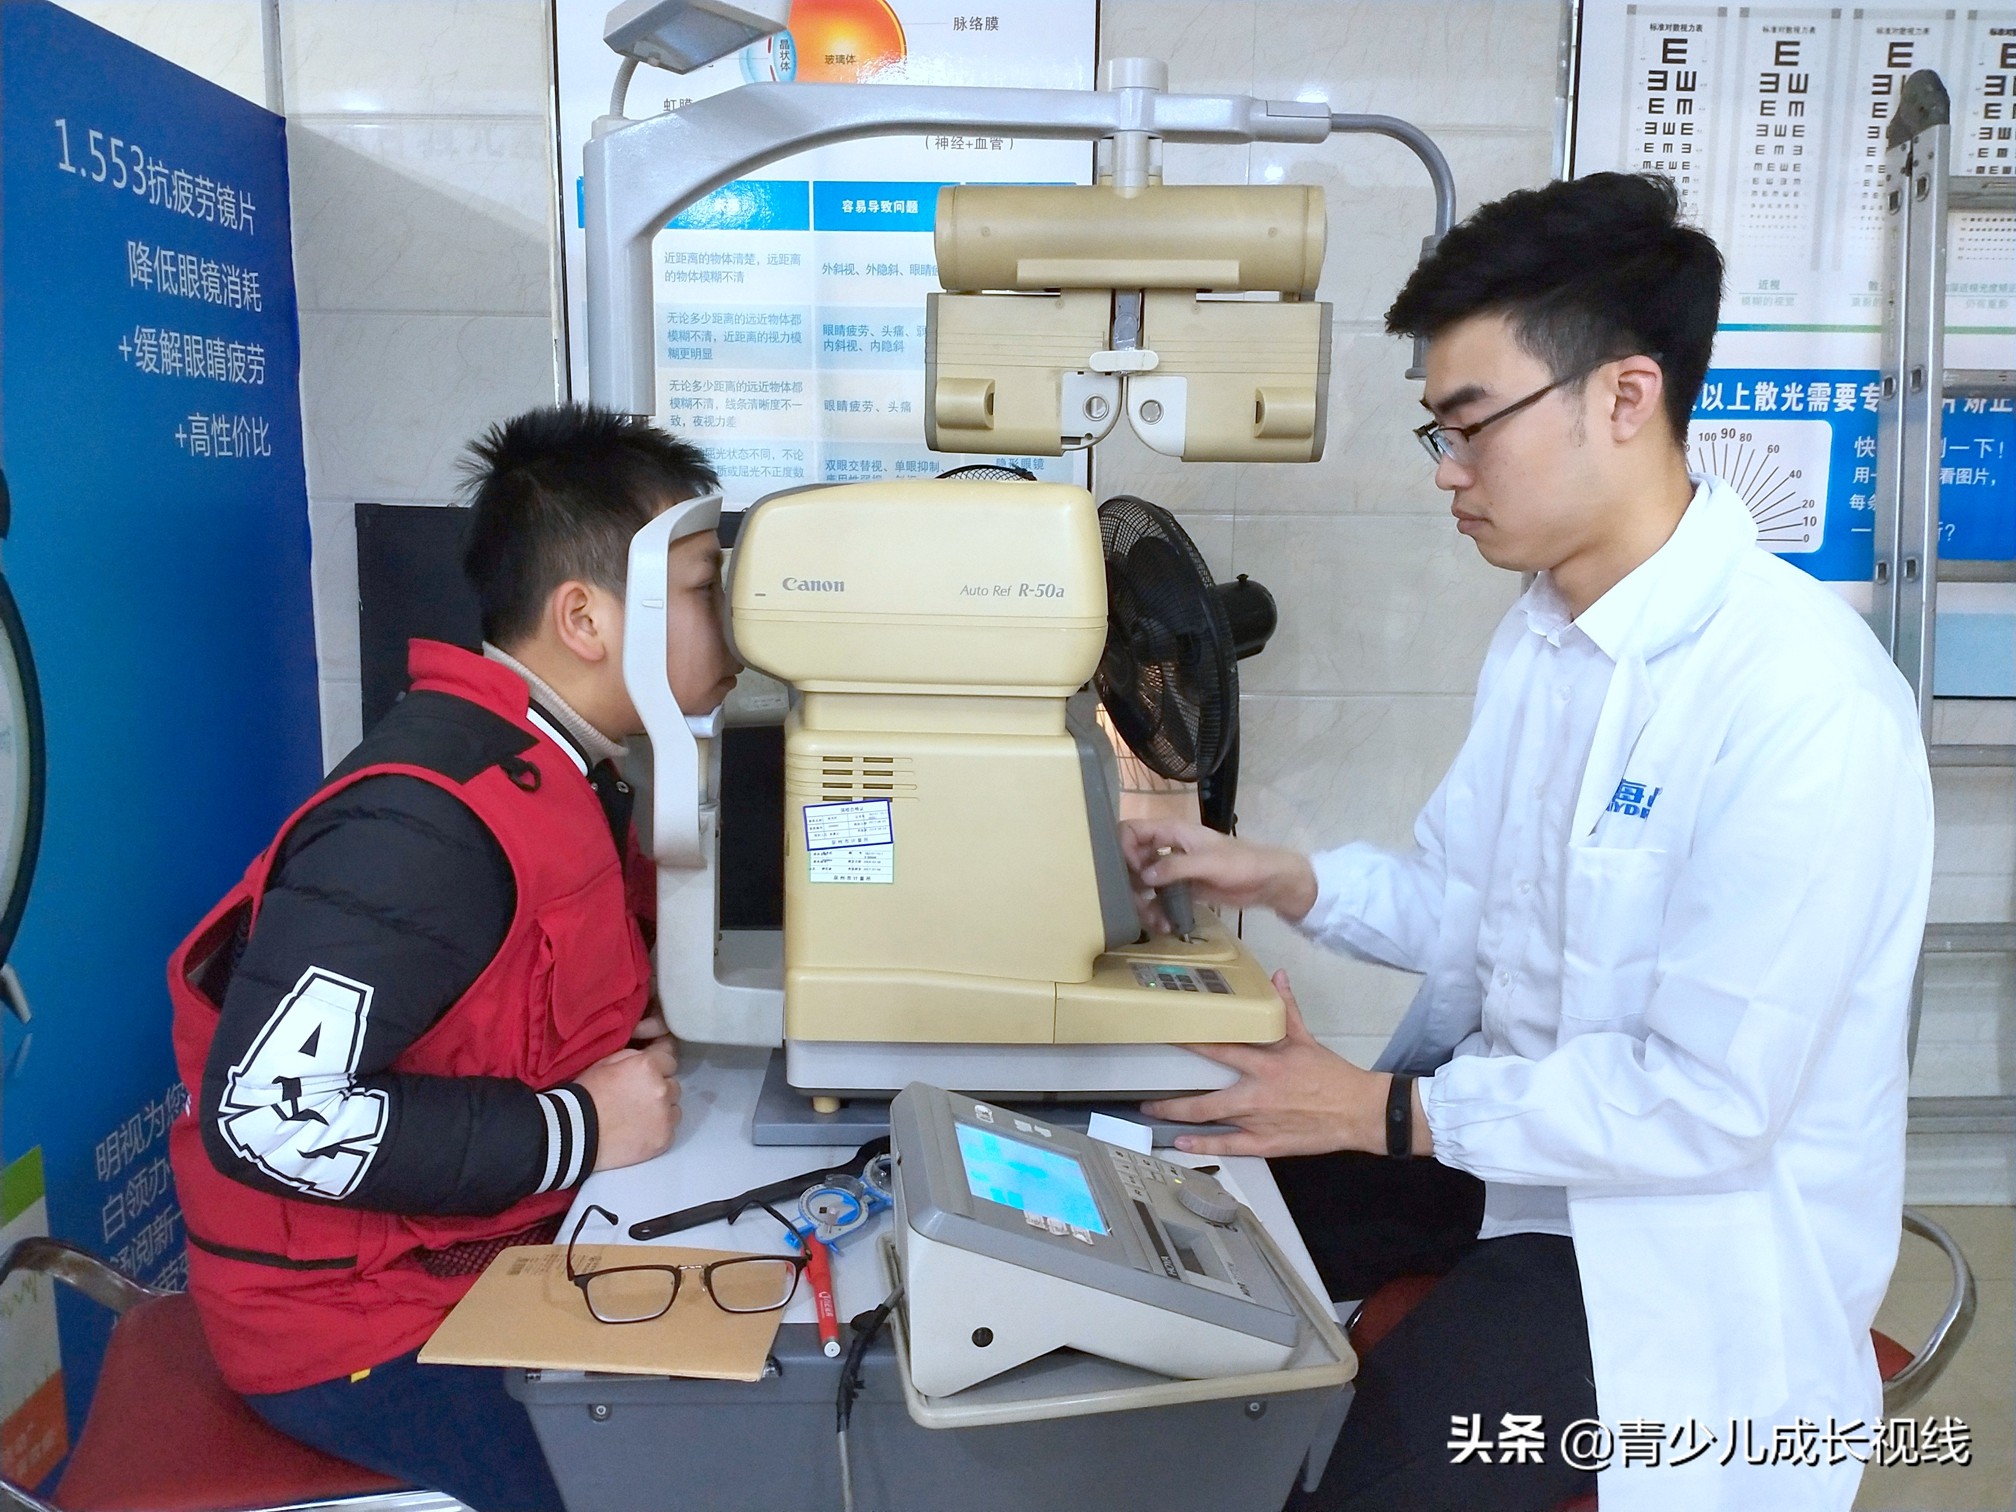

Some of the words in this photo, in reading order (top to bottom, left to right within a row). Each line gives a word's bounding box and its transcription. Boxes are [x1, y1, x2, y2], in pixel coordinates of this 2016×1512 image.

[953, 16, 1000, 32] 脉络膜
[778, 39, 791, 72] 晶状体
[824, 54, 857, 66] 玻璃体
[55, 117, 257, 236] 1.553抗疲劳镜片
[841, 199, 919, 214] 容易导致问题
[127, 240, 263, 313] 降低眼镜消耗
[664, 270, 744, 284] 的物体模糊不清
[667, 312, 801, 326] 无论多少距离的远近物体都
[667, 330, 802, 344] 模糊不清，近距离的视力模
[823, 338, 905, 353] 内斜视、内隐斜
[118, 325, 265, 385] +缓解眼睛疲劳
[667, 347, 714, 361] 糊更明显
[668, 380, 804, 395] 无论多少距离的远近物体都
[669, 398, 804, 412] 模糊不清，线条清晰度不一
[823, 400, 912, 414] 眼睛疲劳、头痛
[669, 415, 737, 428] 致，夜视力差
[175, 412, 272, 458] +高性价比
[1698, 432, 1717, 442] 100
[1720, 427, 1736, 439] 90
[1739, 433, 1753, 442] 80
[1767, 444, 1780, 454] 60
[1854, 435, 1876, 458] 快
[701, 447, 804, 462] 屈光状态不同，不论
[1788, 469, 1802, 480] 40
[1801, 499, 1815, 509] 20
[1802, 516, 1817, 527] 10
[1802, 534, 1810, 543] 0
[781, 576, 845, 593] Canon
[960, 584, 989, 597] Auto
[992, 584, 1013, 597] Ref
[1017, 582, 1066, 599] R-50a
